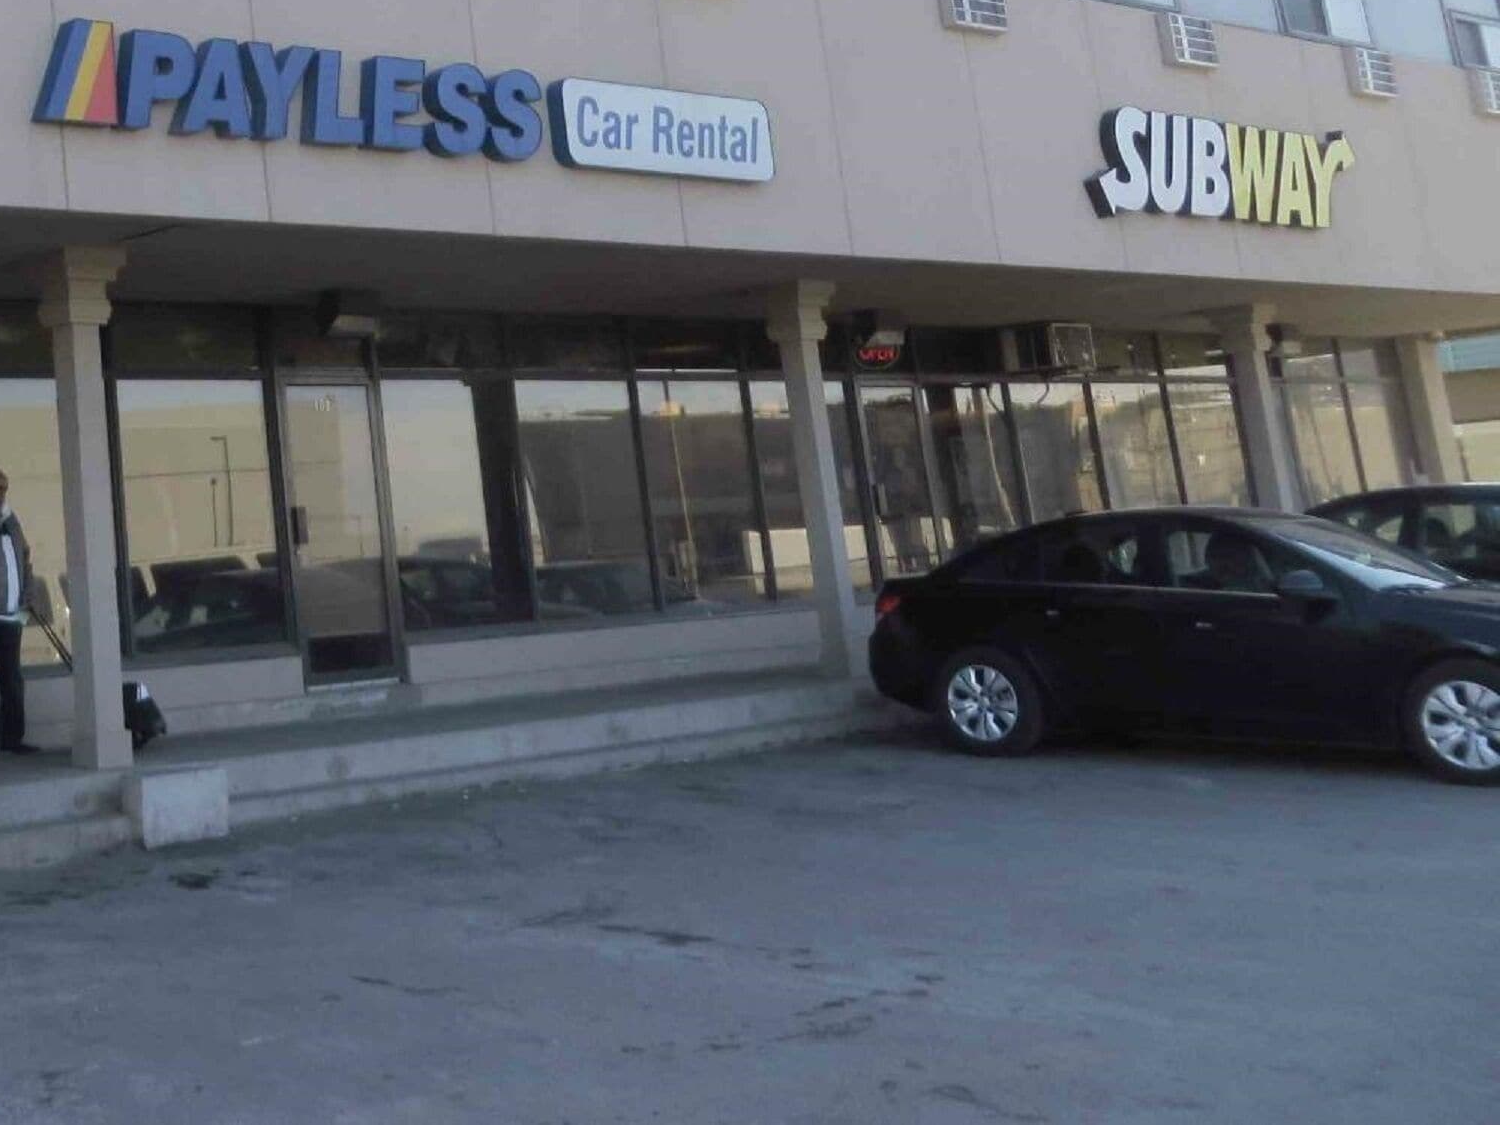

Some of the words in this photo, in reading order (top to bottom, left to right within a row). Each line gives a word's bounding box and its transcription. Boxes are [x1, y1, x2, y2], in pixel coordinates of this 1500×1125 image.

[118, 28, 542, 163] PAYLESS
[576, 95, 639, 151] Car
[652, 104, 759, 165] Rental
[1086, 106, 1356, 228] SUBWAY
